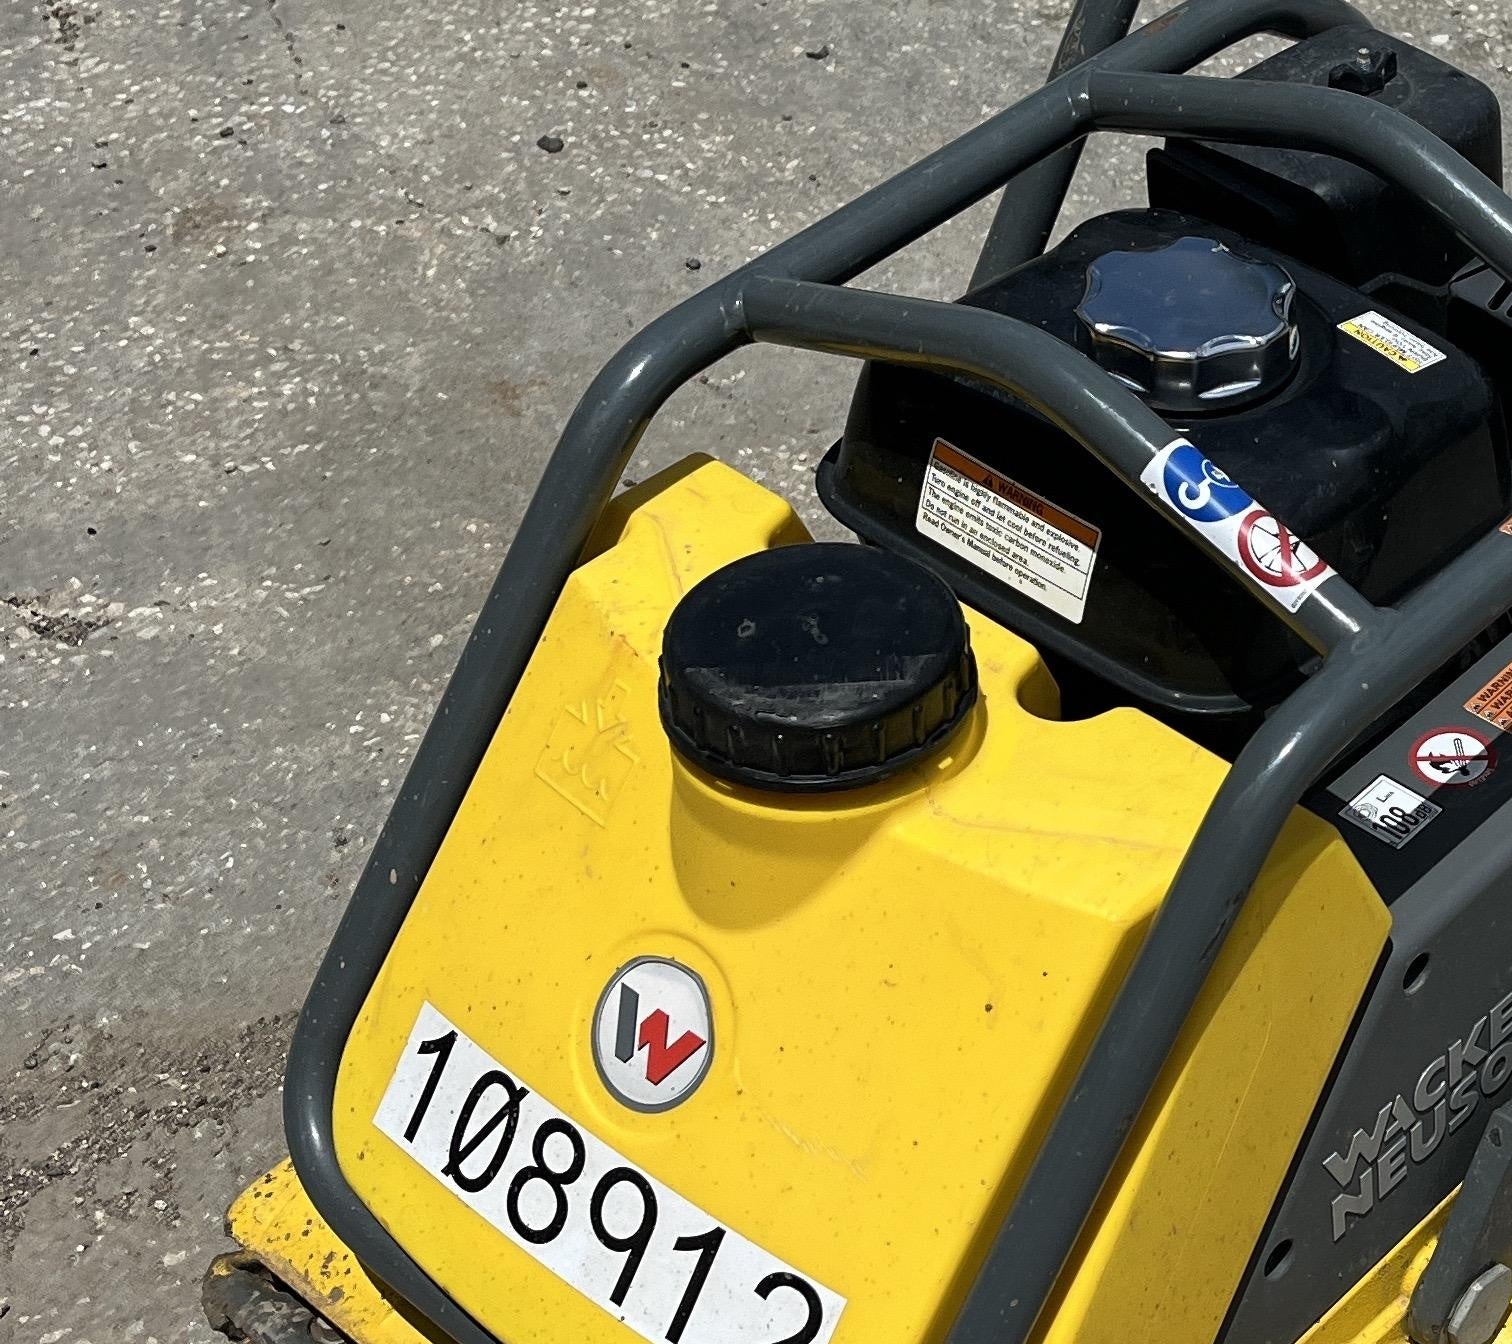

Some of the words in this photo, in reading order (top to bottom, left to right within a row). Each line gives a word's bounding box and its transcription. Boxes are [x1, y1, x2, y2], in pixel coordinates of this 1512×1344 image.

[1354, 329, 1398, 356] CAUTION
[927, 486, 940, 500] The
[941, 495, 964, 516] engine
[965, 509, 984, 526] emits
[984, 520, 1003, 537] toxic
[1003, 531, 1029, 552] carbon
[946, 483, 969, 503] engine
[970, 495, 981, 508] off
[981, 502, 995, 517] and
[996, 510, 1006, 523] let
[1006, 517, 1022, 533] cool
[1023, 526, 1046, 546] before
[991, 495, 1029, 523] flammable
[1030, 518, 1045, 532] and
[1045, 527, 1080, 554] explosive.
[997, 480, 1044, 516] WARNING
[922, 511, 939, 528] Read
[966, 537, 990, 558] Manual
[991, 552, 1013, 571] before
[925, 498, 935, 510] Do
[947, 512, 959, 525] run
[979, 530, 1010, 555] enclosed
[1011, 550, 1029, 566] area.
[1372, 806, 1420, 840] 108
